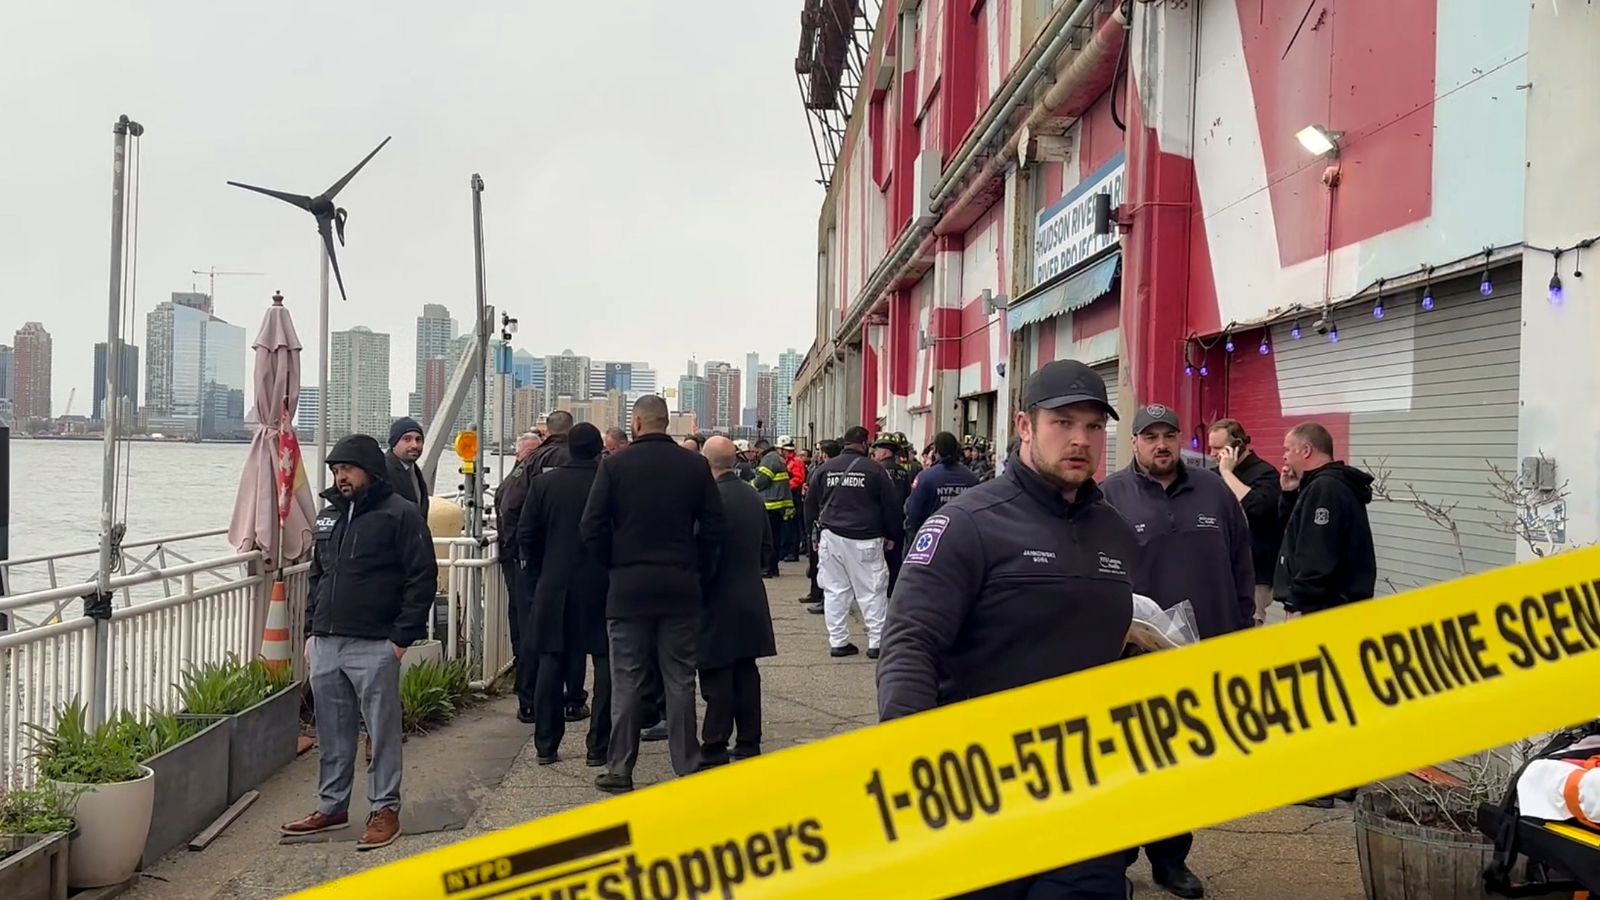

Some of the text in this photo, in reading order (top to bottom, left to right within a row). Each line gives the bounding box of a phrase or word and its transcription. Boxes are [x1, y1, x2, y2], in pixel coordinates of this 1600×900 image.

[866, 579, 1600, 842] 1-800-577-TIPS (8477) CRIME SCEN
[446, 857, 512, 891] NYPD
